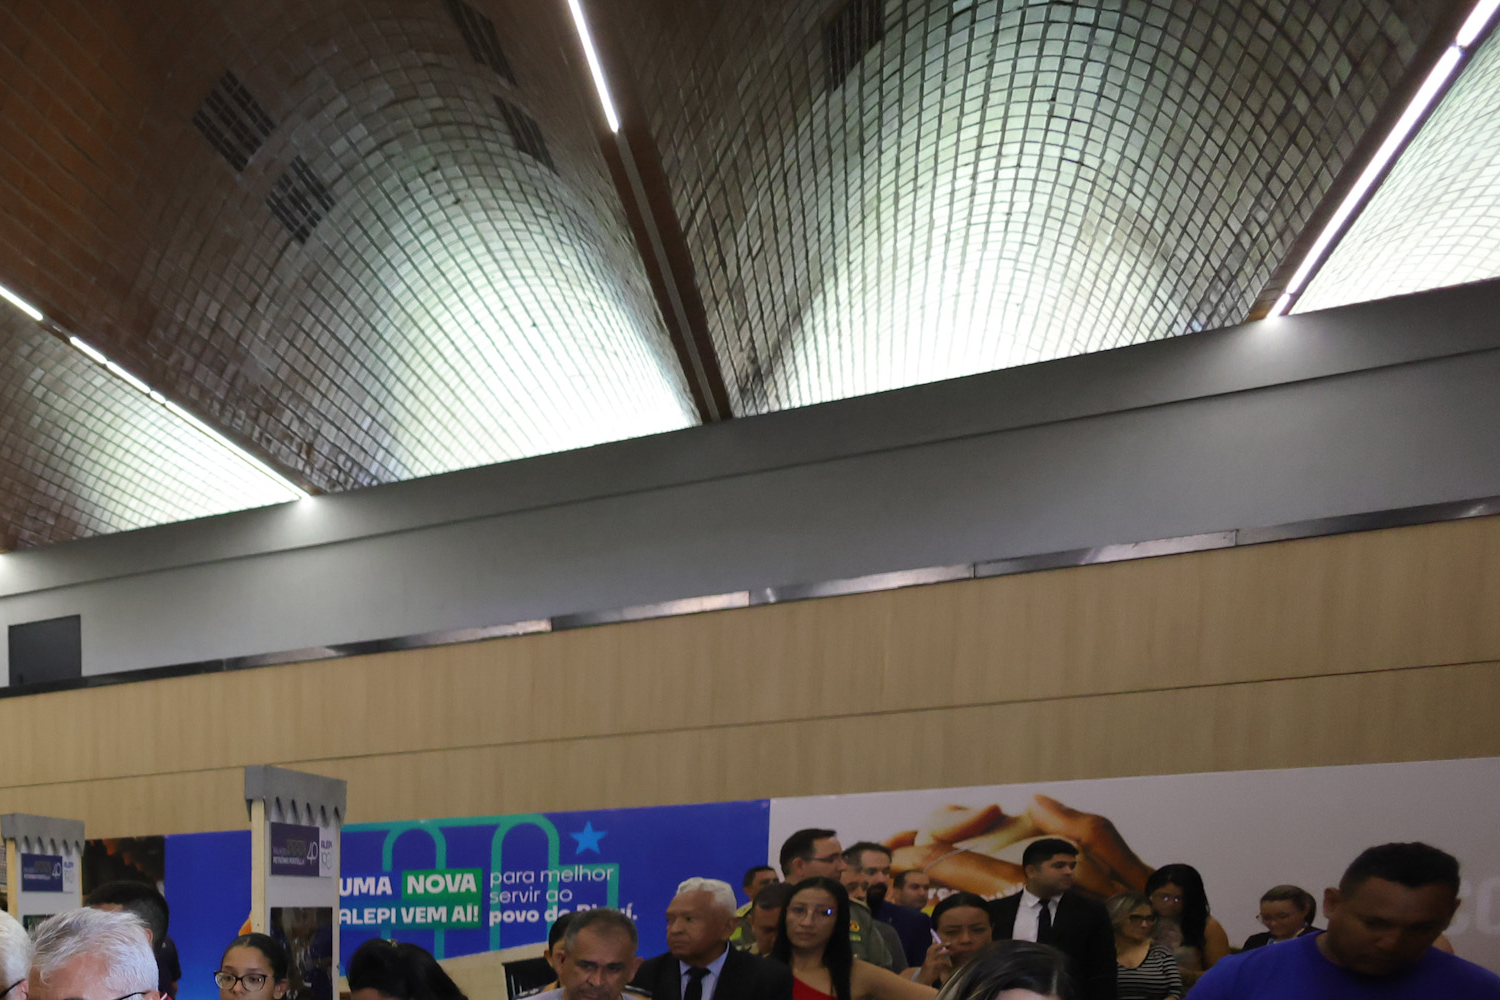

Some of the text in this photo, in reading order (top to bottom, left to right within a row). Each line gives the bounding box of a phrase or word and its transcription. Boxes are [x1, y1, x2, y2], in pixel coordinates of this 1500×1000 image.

[340, 873, 477, 896] UMA NOVA
[490, 864, 614, 887] para melhor
[489, 886, 572, 904] servir ao
[339, 903, 479, 925] ALEPI VEM AÍ!
[489, 909, 538, 926] povo
